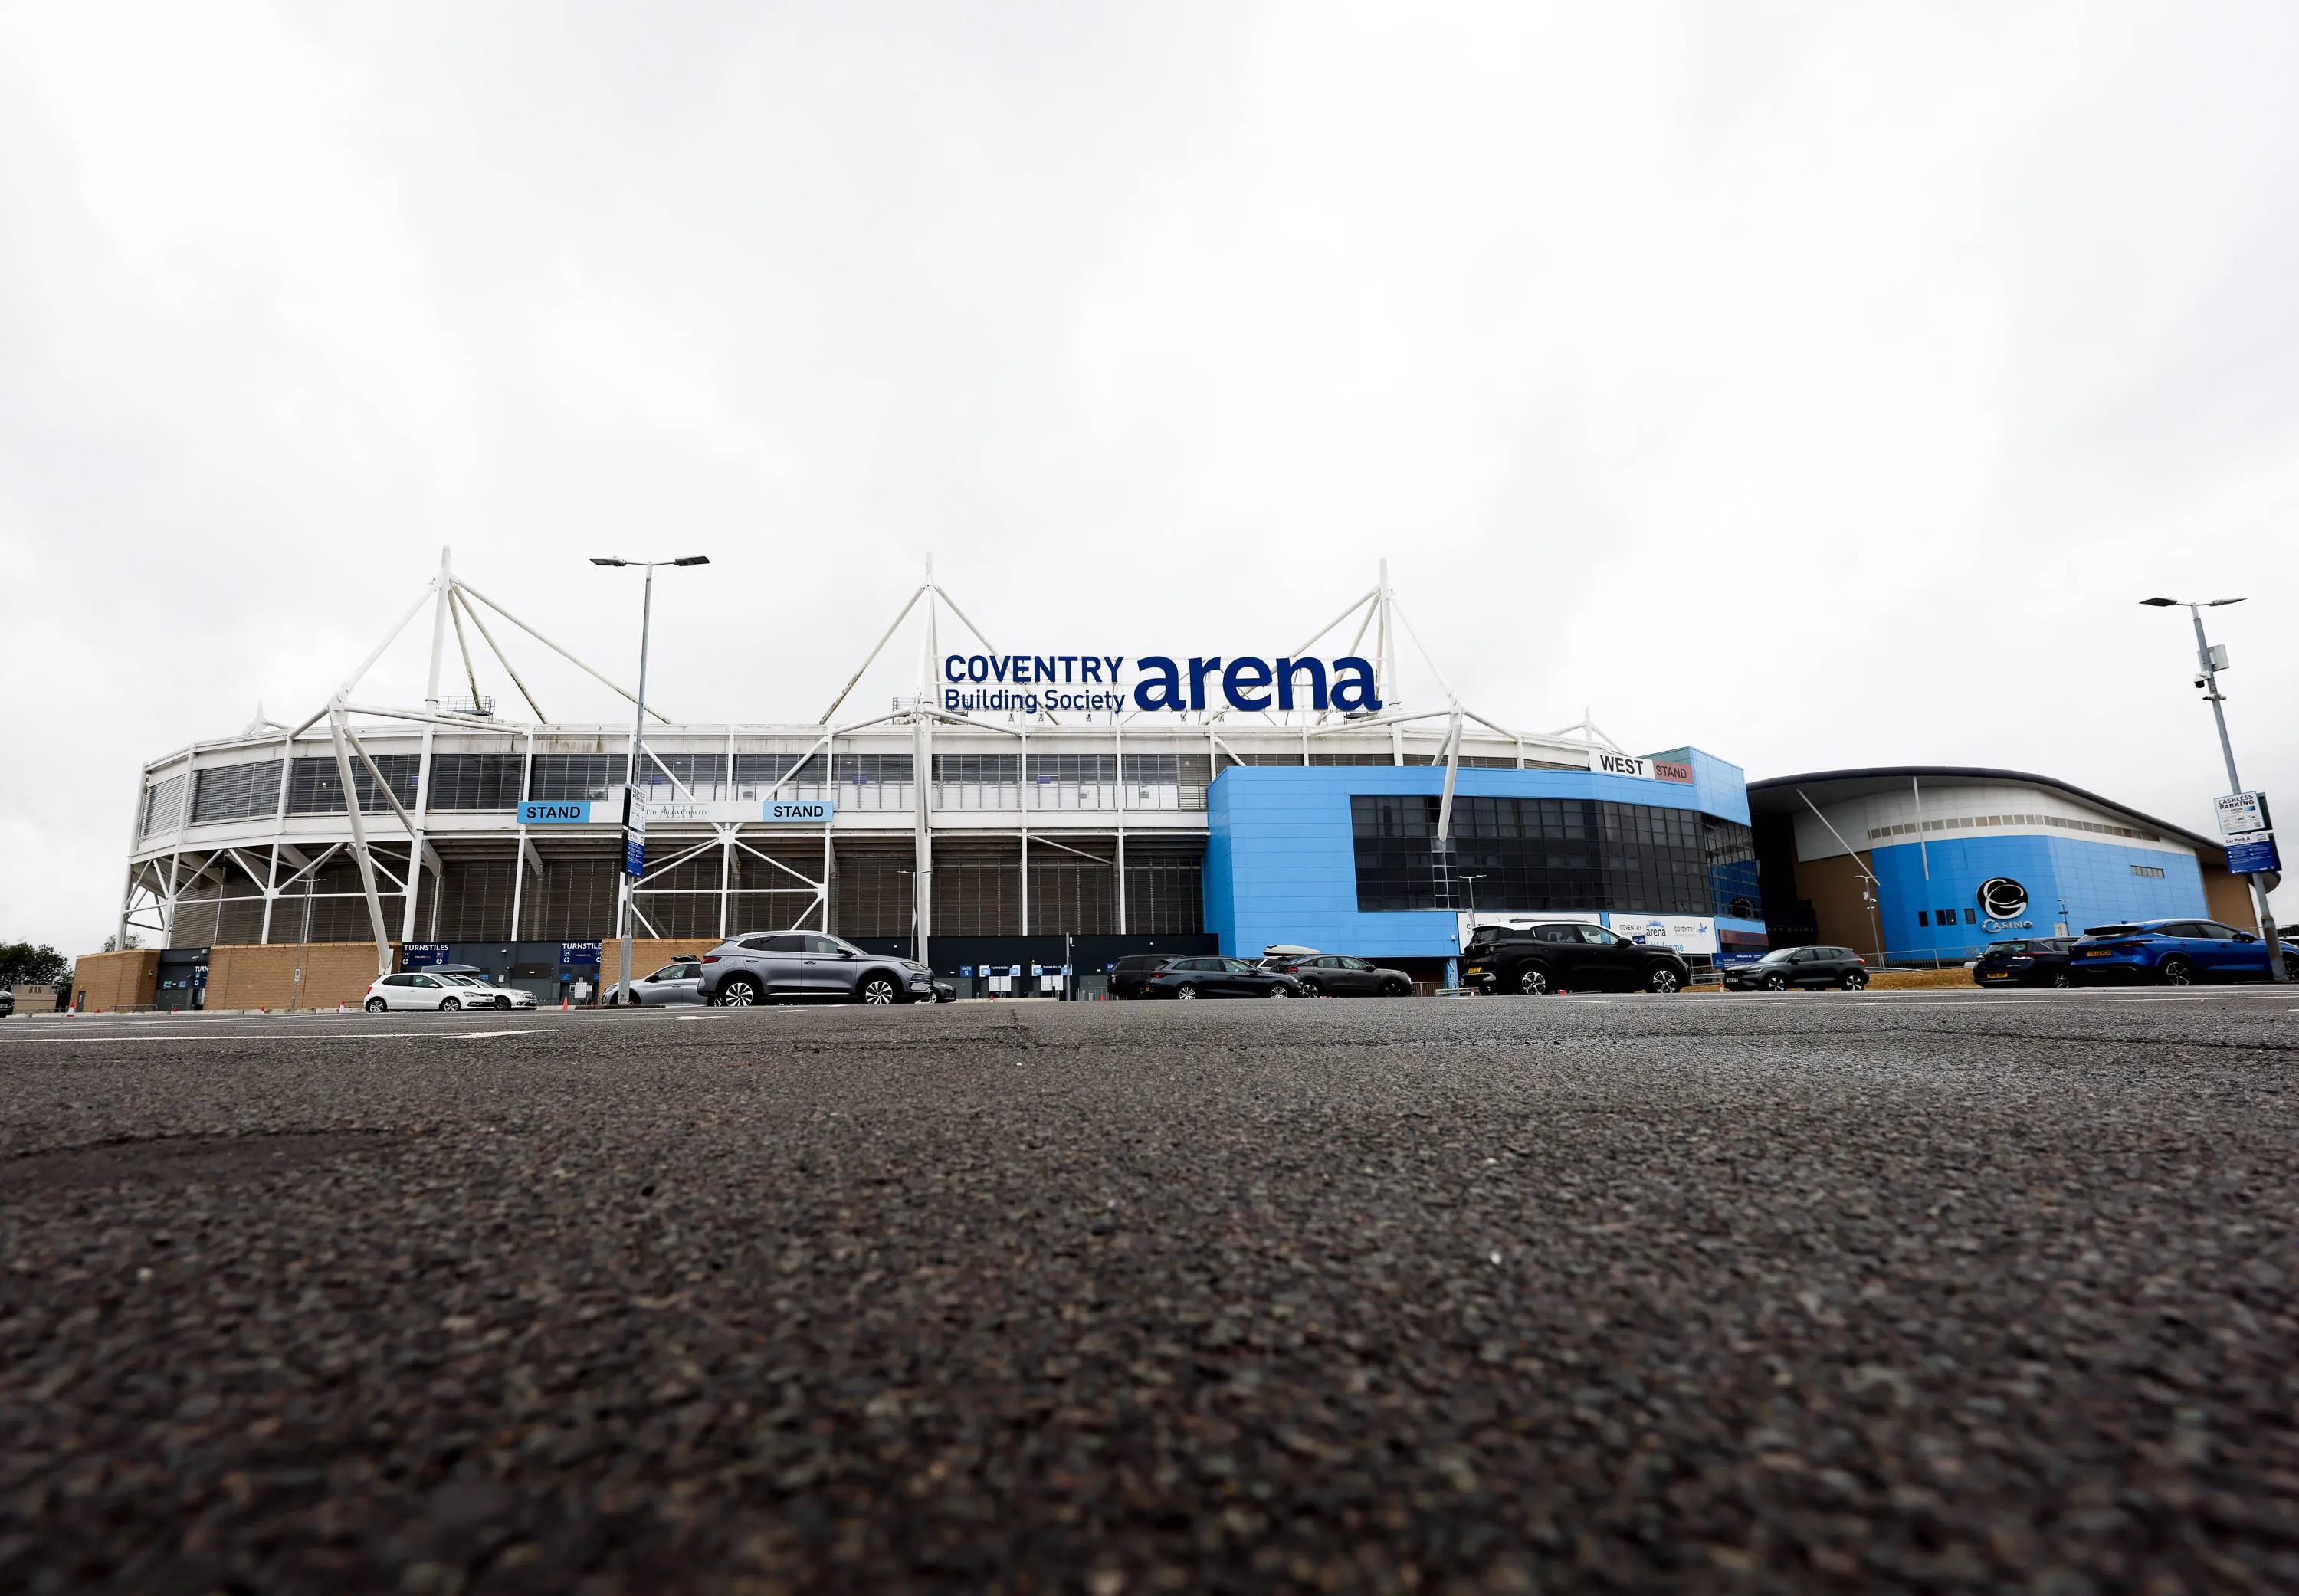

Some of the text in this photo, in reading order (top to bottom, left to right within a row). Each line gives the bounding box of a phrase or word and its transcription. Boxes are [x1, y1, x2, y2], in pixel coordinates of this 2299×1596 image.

[945, 655, 1124, 683] COVENTRY
[1134, 656, 1382, 711] arena
[945, 689, 1125, 715] Building Society
[1599, 755, 1644, 775] WEST
[1655, 765, 1687, 779] STAND
[2218, 795, 2253, 805] CASHLESS
[2219, 800, 2254, 809] PARKING
[526, 806, 581, 819] STAND
[773, 805, 824, 818] STAND
[1982, 919, 2033, 932] CASINO
[1646, 929, 1666, 937] arena
